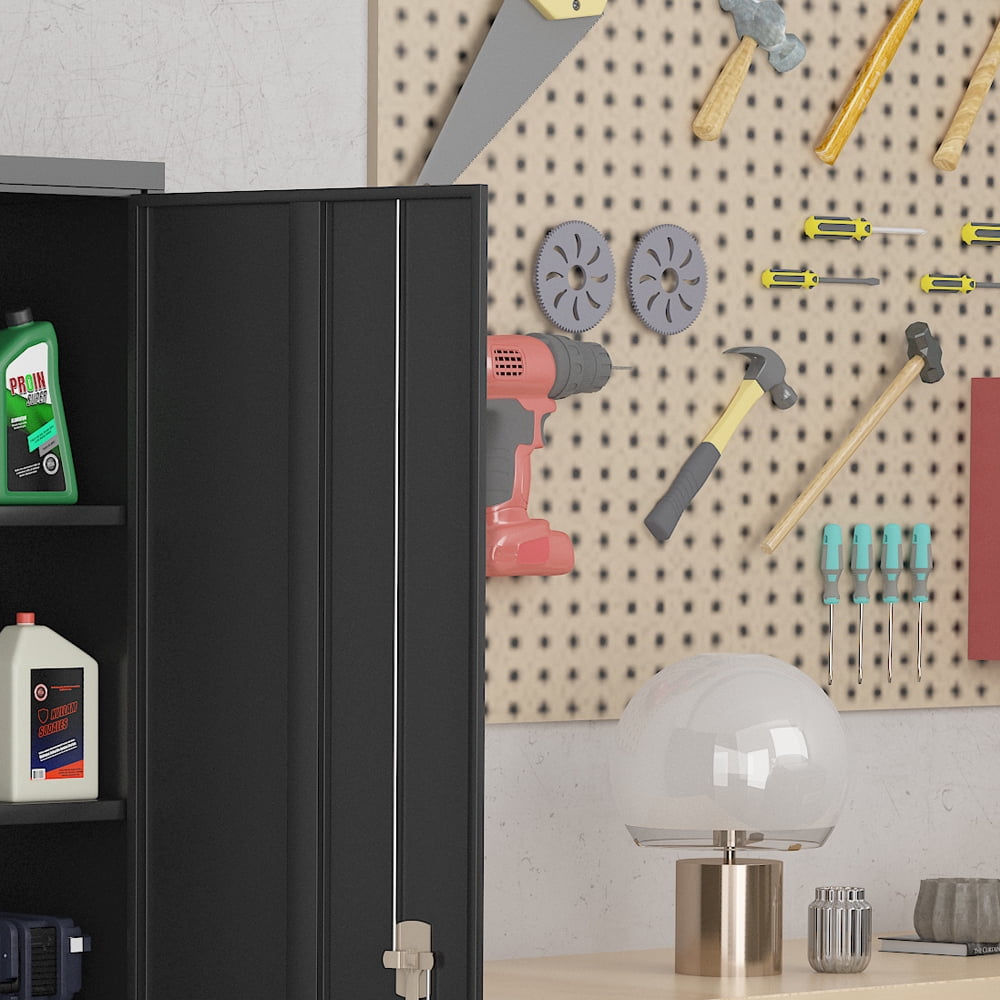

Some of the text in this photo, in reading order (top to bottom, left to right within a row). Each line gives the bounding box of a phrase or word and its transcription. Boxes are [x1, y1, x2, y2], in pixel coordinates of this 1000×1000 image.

[9, 371, 46, 395] PROIN
[26, 390, 47, 406] SUPER
[50, 701, 78, 720] NULLAM
[38, 718, 69, 738] SODALES
